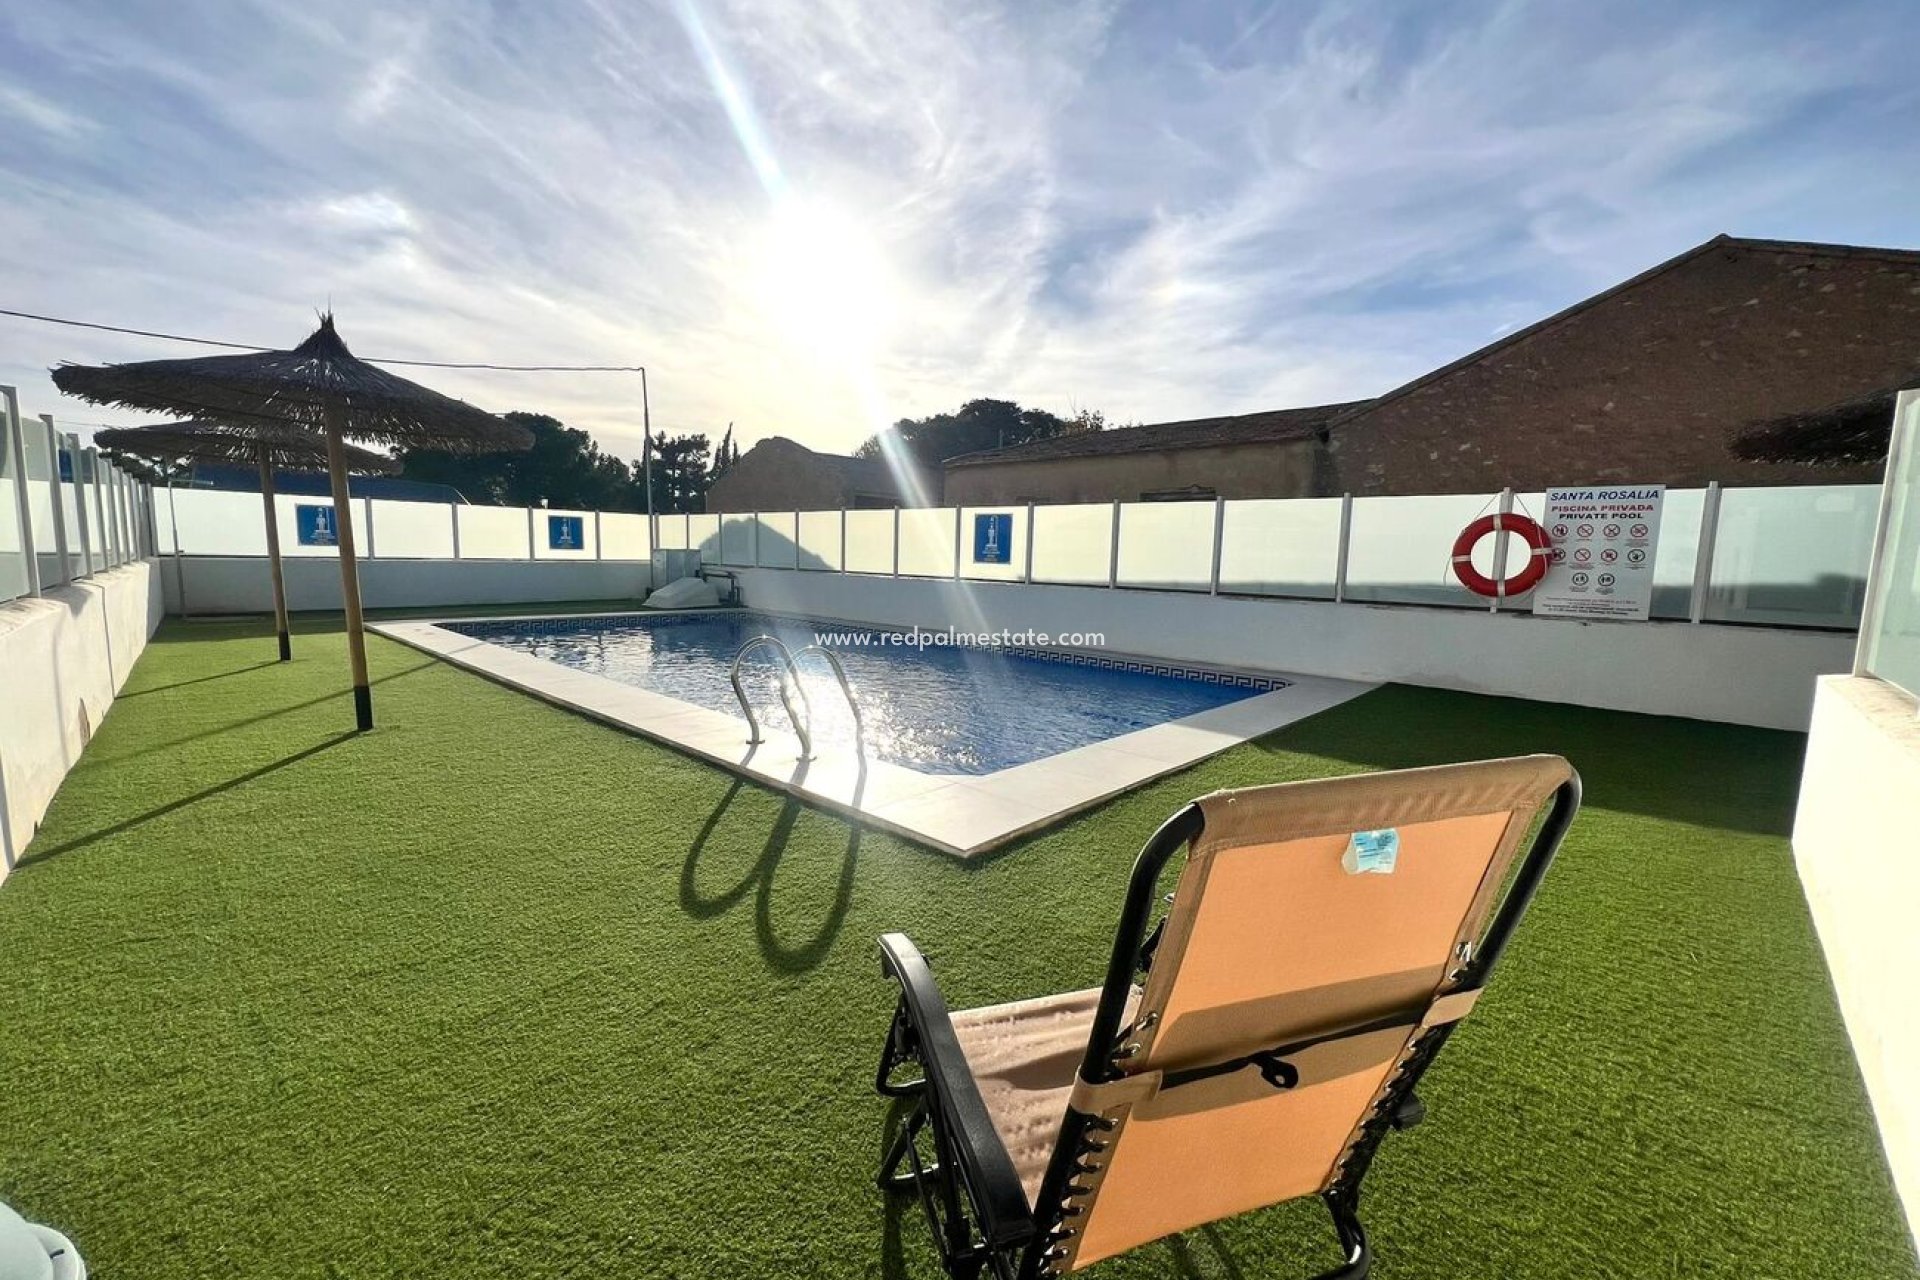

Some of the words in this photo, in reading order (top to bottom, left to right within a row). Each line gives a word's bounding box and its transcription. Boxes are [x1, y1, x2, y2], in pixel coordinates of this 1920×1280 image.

[1550, 491, 1594, 501] SANTA
[1598, 489, 1660, 500] ROSALIA
[1551, 505, 1598, 513] PISCINA
[1600, 504, 1654, 512] PRIVADA
